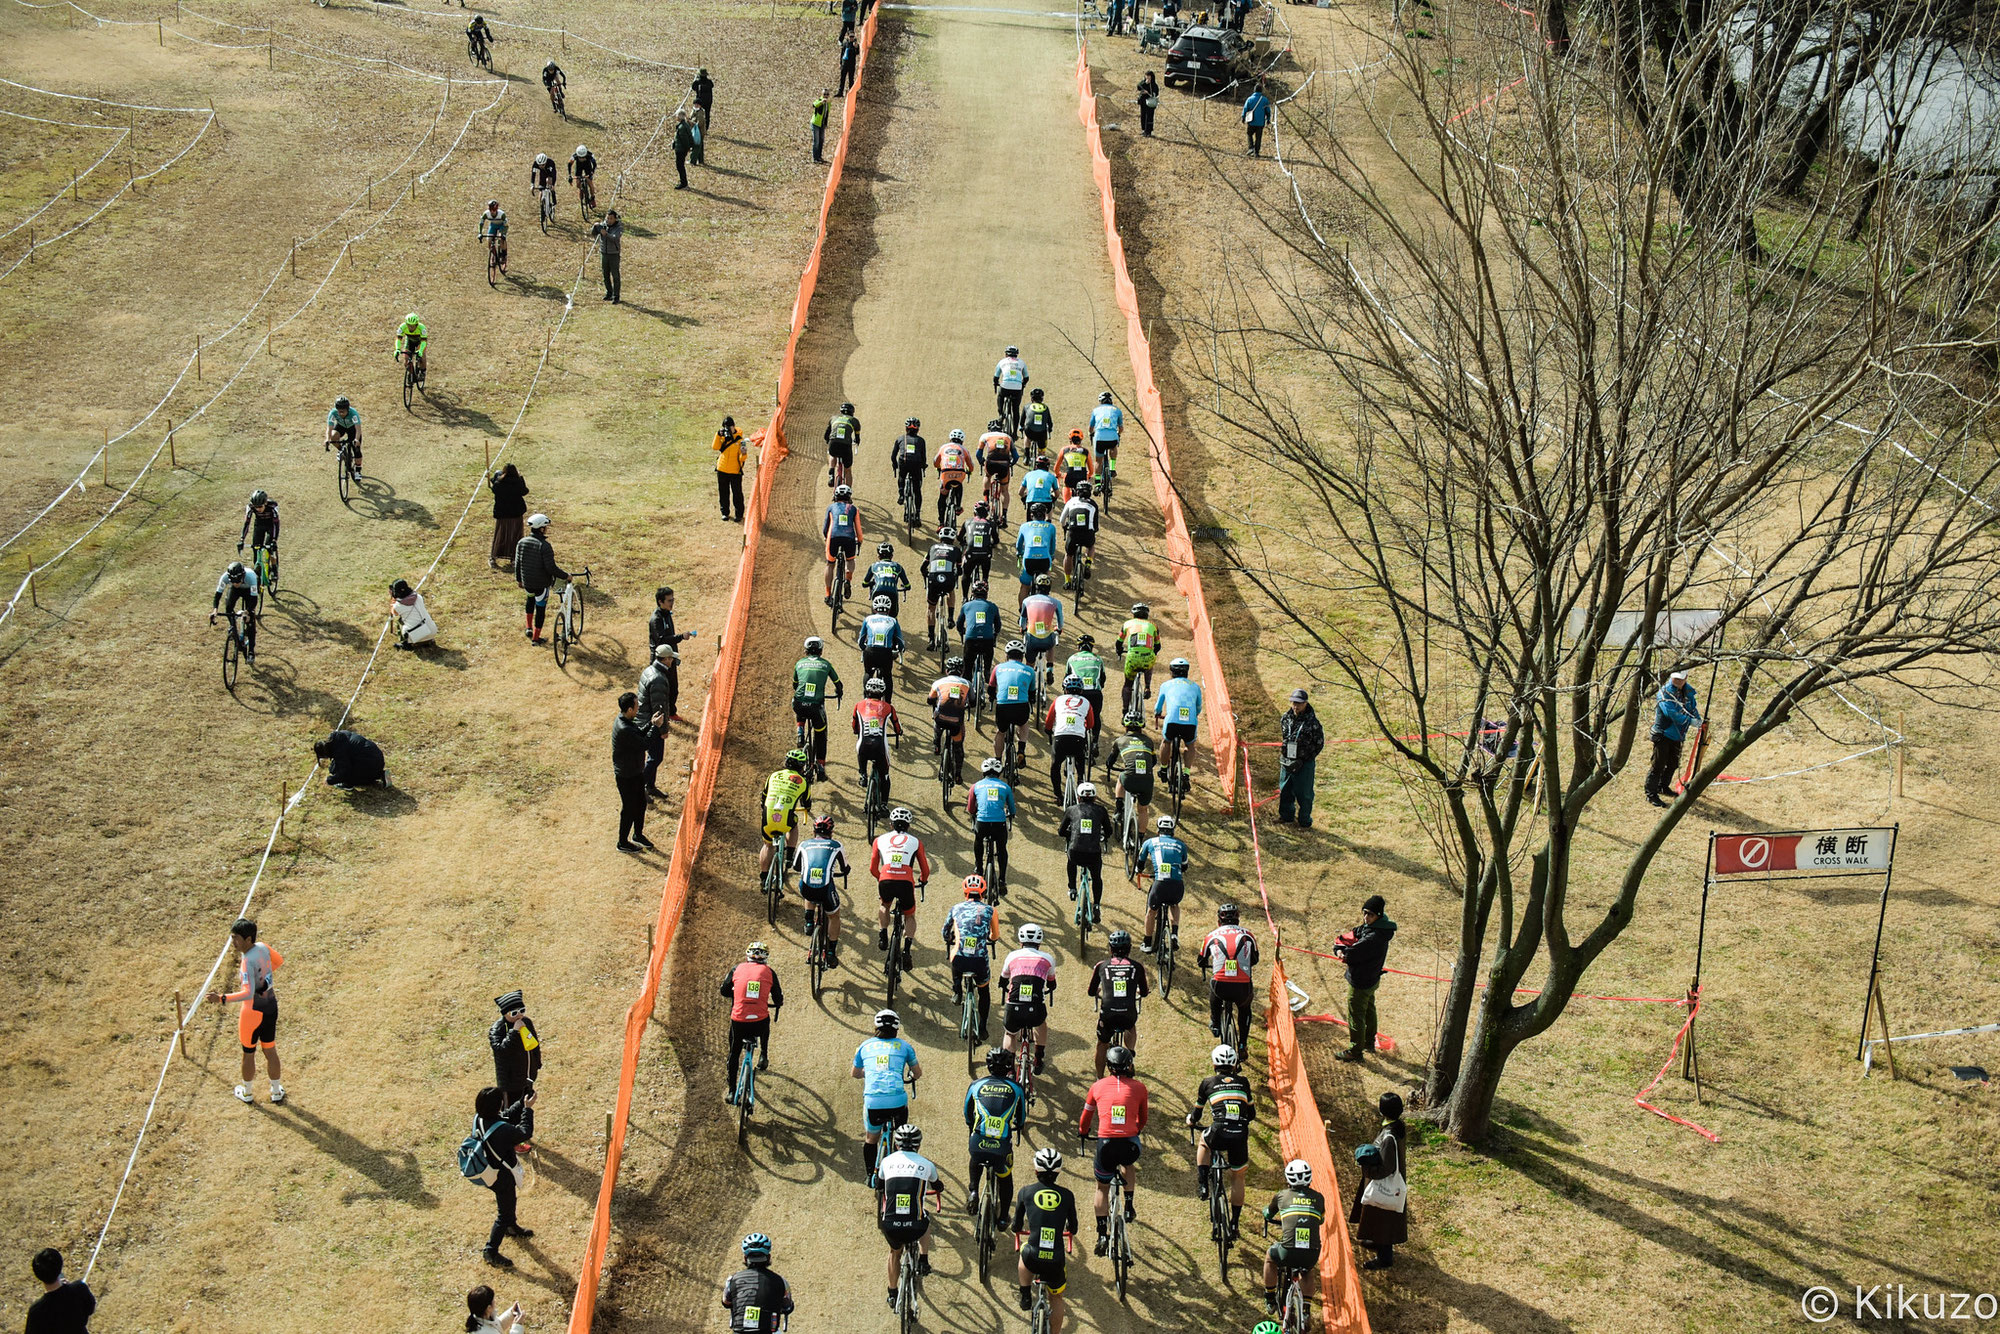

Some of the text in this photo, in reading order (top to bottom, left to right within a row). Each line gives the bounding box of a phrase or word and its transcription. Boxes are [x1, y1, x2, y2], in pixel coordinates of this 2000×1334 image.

[1008, 687, 1018, 695] 123
[1179, 708, 1189, 716] 122
[1066, 717, 1076, 725] 124
[1081, 820, 1092, 829] 133
[1815, 834, 1868, 856] 横断
[891, 854, 902, 863] 132
[1813, 856, 1869, 865] CROSS WALK
[811, 869, 823, 878] 144
[1160, 864, 1170, 873] 131
[965, 938, 977, 948] 143
[1225, 961, 1237, 970] 140
[747, 982, 760, 992] 138
[1020, 986, 1032, 996] 137
[1114, 981, 1127, 991] 139
[876, 1055, 888, 1065] 145
[1112, 1107, 1125, 1118] 142
[1227, 1104, 1240, 1113] 141
[987, 1118, 1001, 1129] 148
[896, 1196, 910, 1207] 152
[1041, 1230, 1055, 1242] 150
[1296, 1229, 1309, 1240] 146
[746, 1308, 759, 1319] 151
